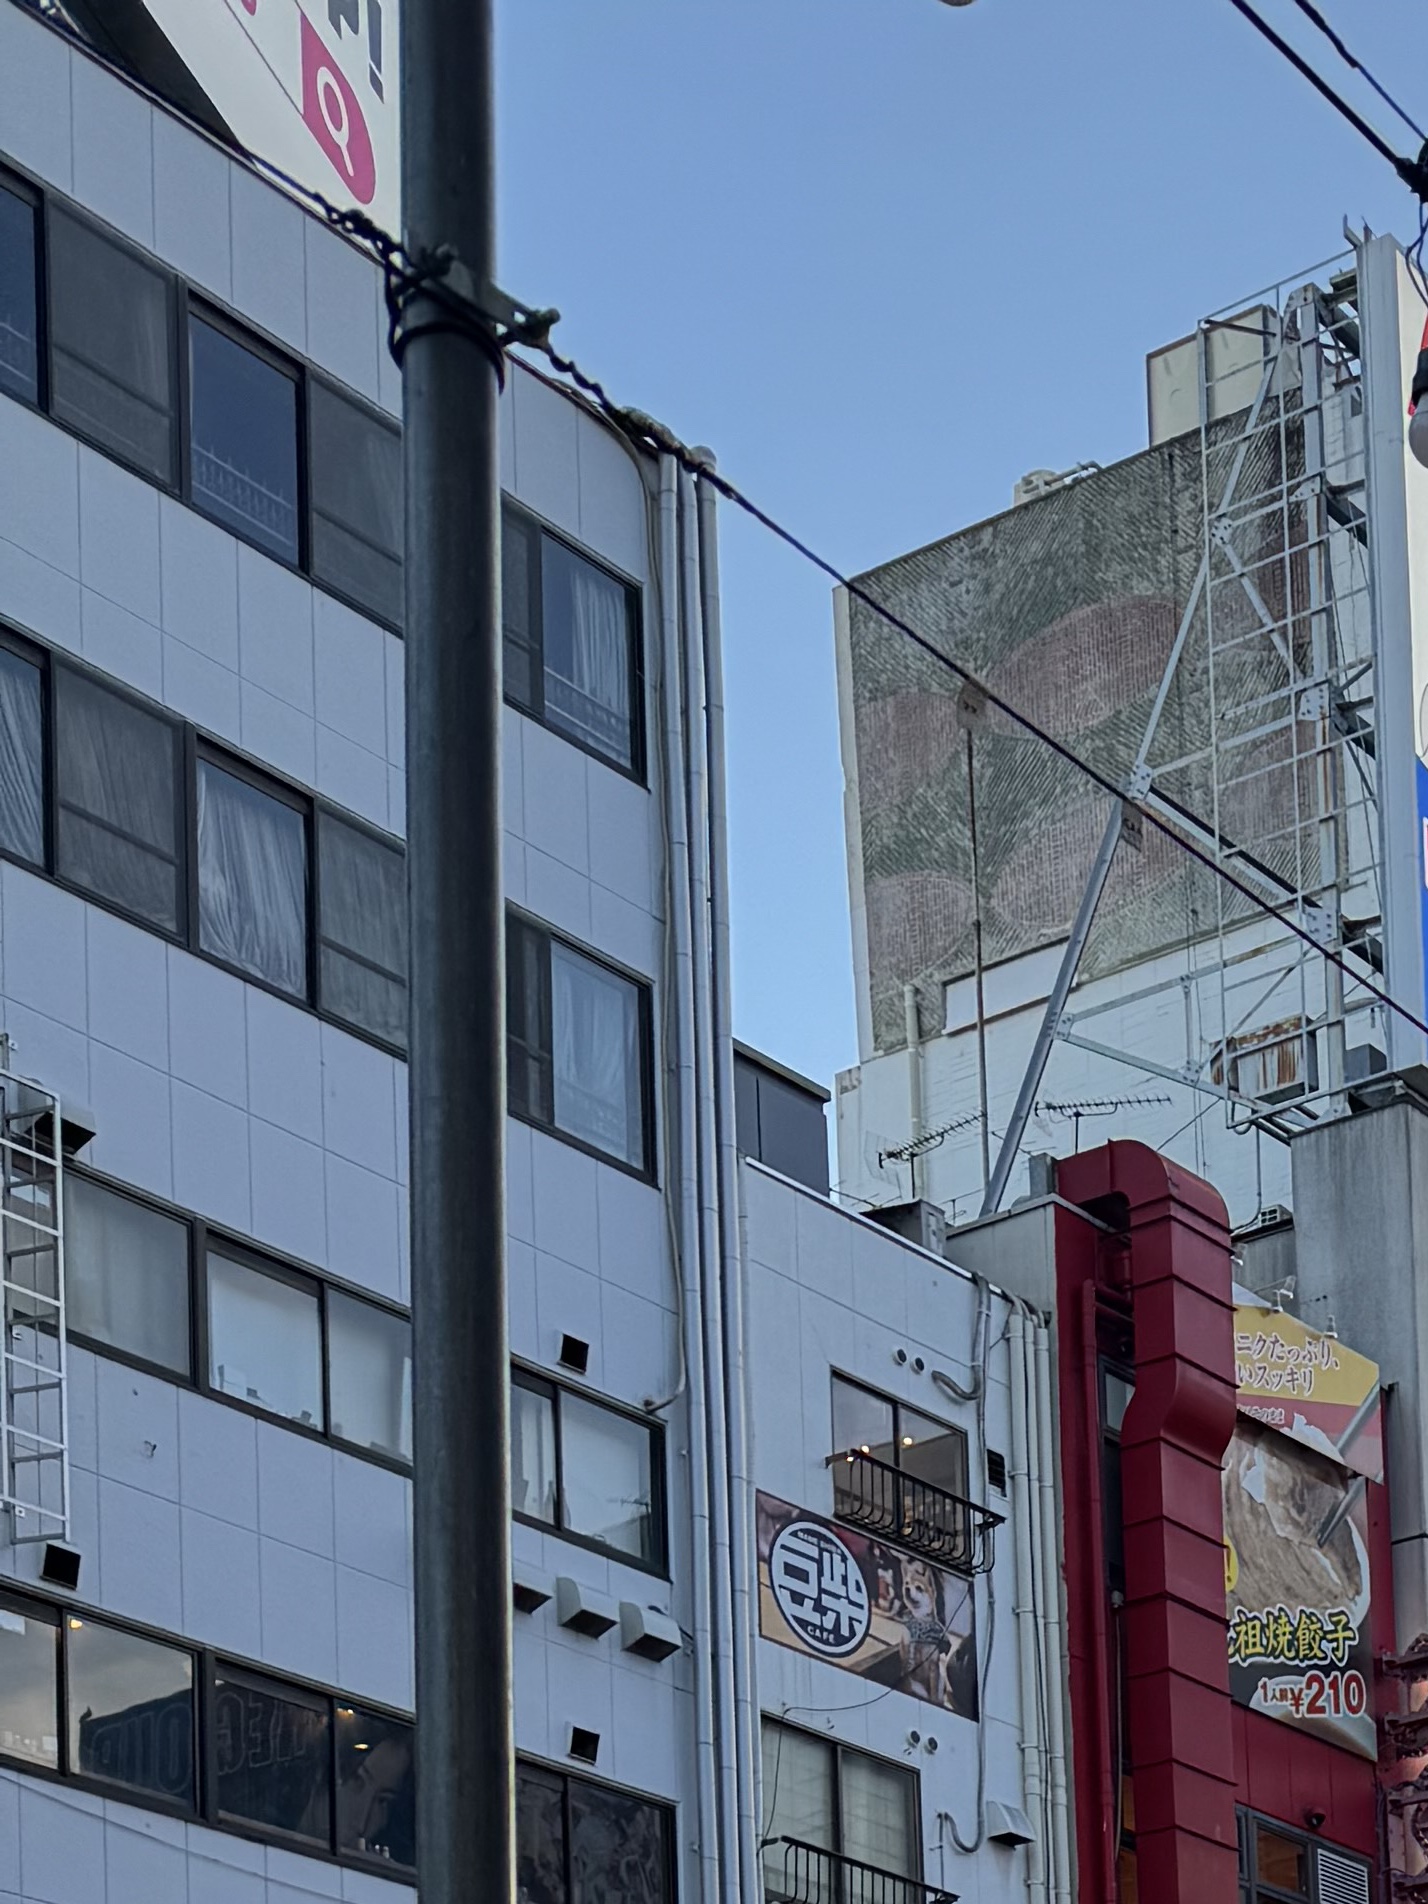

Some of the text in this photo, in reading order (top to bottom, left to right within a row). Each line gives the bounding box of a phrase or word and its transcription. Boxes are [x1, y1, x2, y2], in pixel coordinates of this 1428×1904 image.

[807, 1623, 835, 1643] CAFE
[1227, 1606, 1358, 1663] 祖焼餃子
